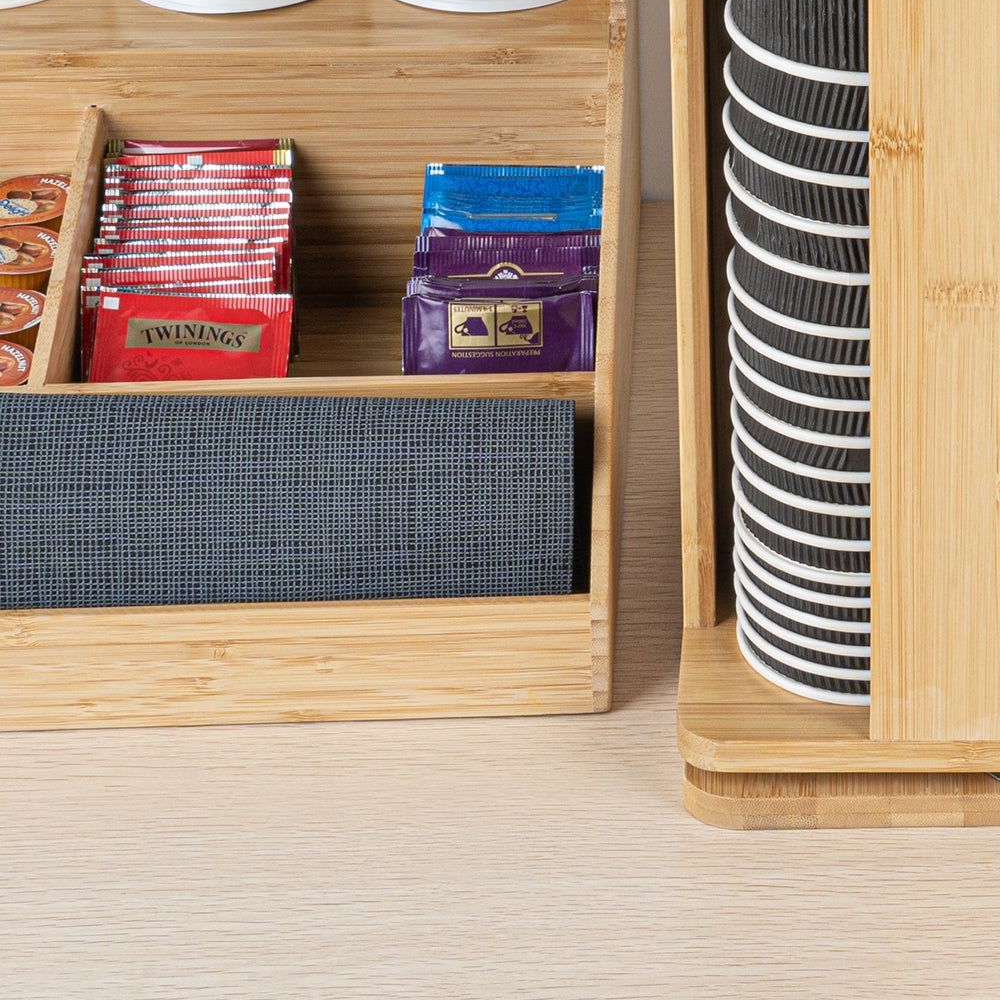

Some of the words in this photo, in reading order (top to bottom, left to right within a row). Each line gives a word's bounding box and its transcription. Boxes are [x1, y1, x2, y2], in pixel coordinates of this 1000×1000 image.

[40, 178, 70, 194] HAZEL
[141, 324, 246, 349] TWININGS
[495, 349, 541, 358] PREPARATION
